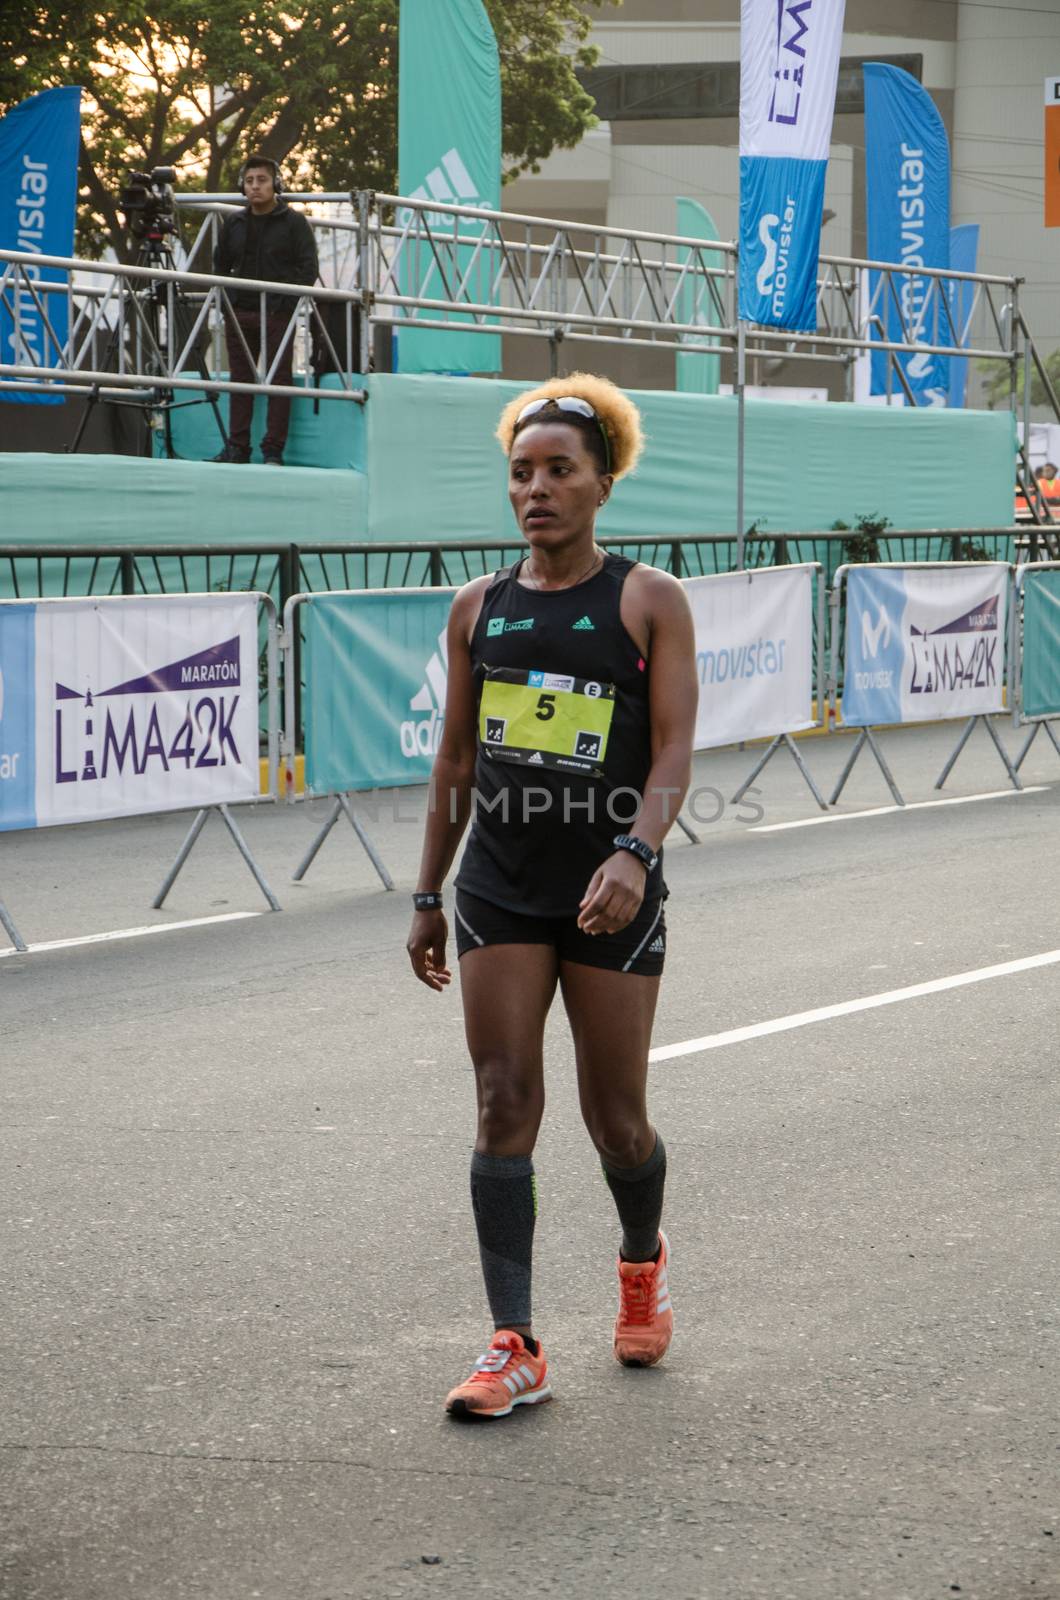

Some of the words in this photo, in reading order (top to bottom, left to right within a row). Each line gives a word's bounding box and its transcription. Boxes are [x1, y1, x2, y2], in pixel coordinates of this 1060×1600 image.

[772, 195, 797, 319] movistar
[181, 661, 239, 684] MARATÓN
[696, 637, 785, 686] movistar
[910, 635, 997, 694] LIMA42K
[535, 693, 556, 721] 5
[588, 684, 597, 697] E
[55, 688, 241, 784] LIMA42K
